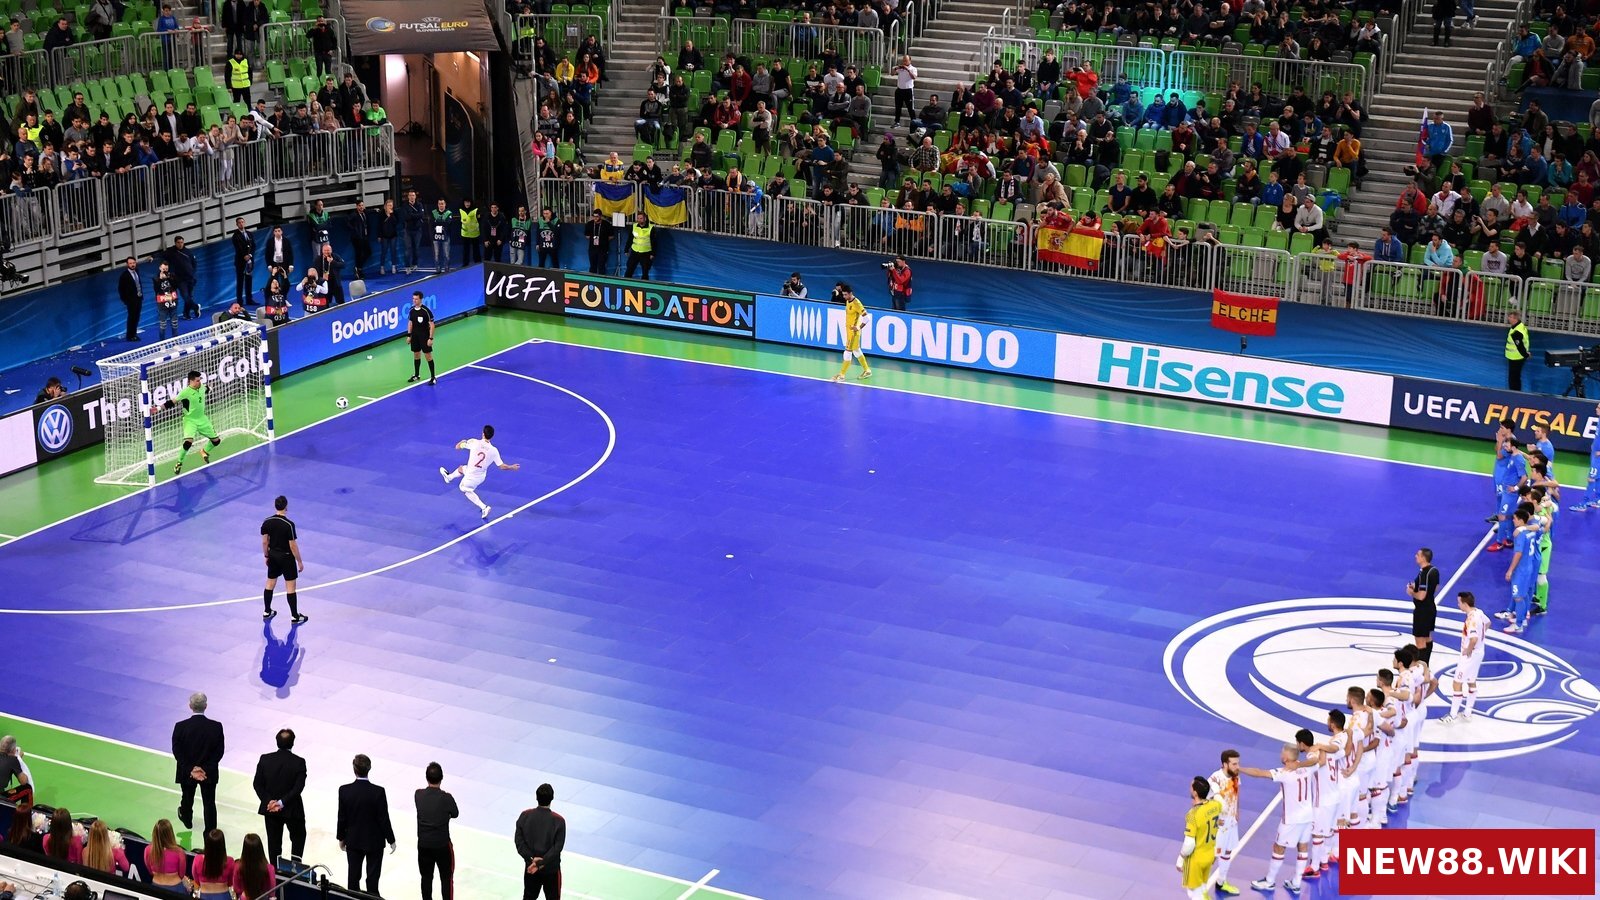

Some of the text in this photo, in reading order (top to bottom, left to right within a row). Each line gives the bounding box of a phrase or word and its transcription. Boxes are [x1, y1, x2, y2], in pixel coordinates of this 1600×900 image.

[399, 20, 469, 30] FUTSAL EURO
[485, 271, 754, 328] UEFA FOUNDATION
[331, 294, 437, 345] Booking.cm
[826, 307, 1019, 369] MONDO
[1097, 342, 1345, 414] Hisense
[83, 397, 131, 429] The
[1403, 391, 1480, 424] UEFA
[1484, 402, 1581, 438] FUTSAL
[474, 451, 486, 469] 2
[1327, 757, 1336, 782] 5
[1297, 777, 1308, 802] 11
[1206, 815, 1220, 844] 13
